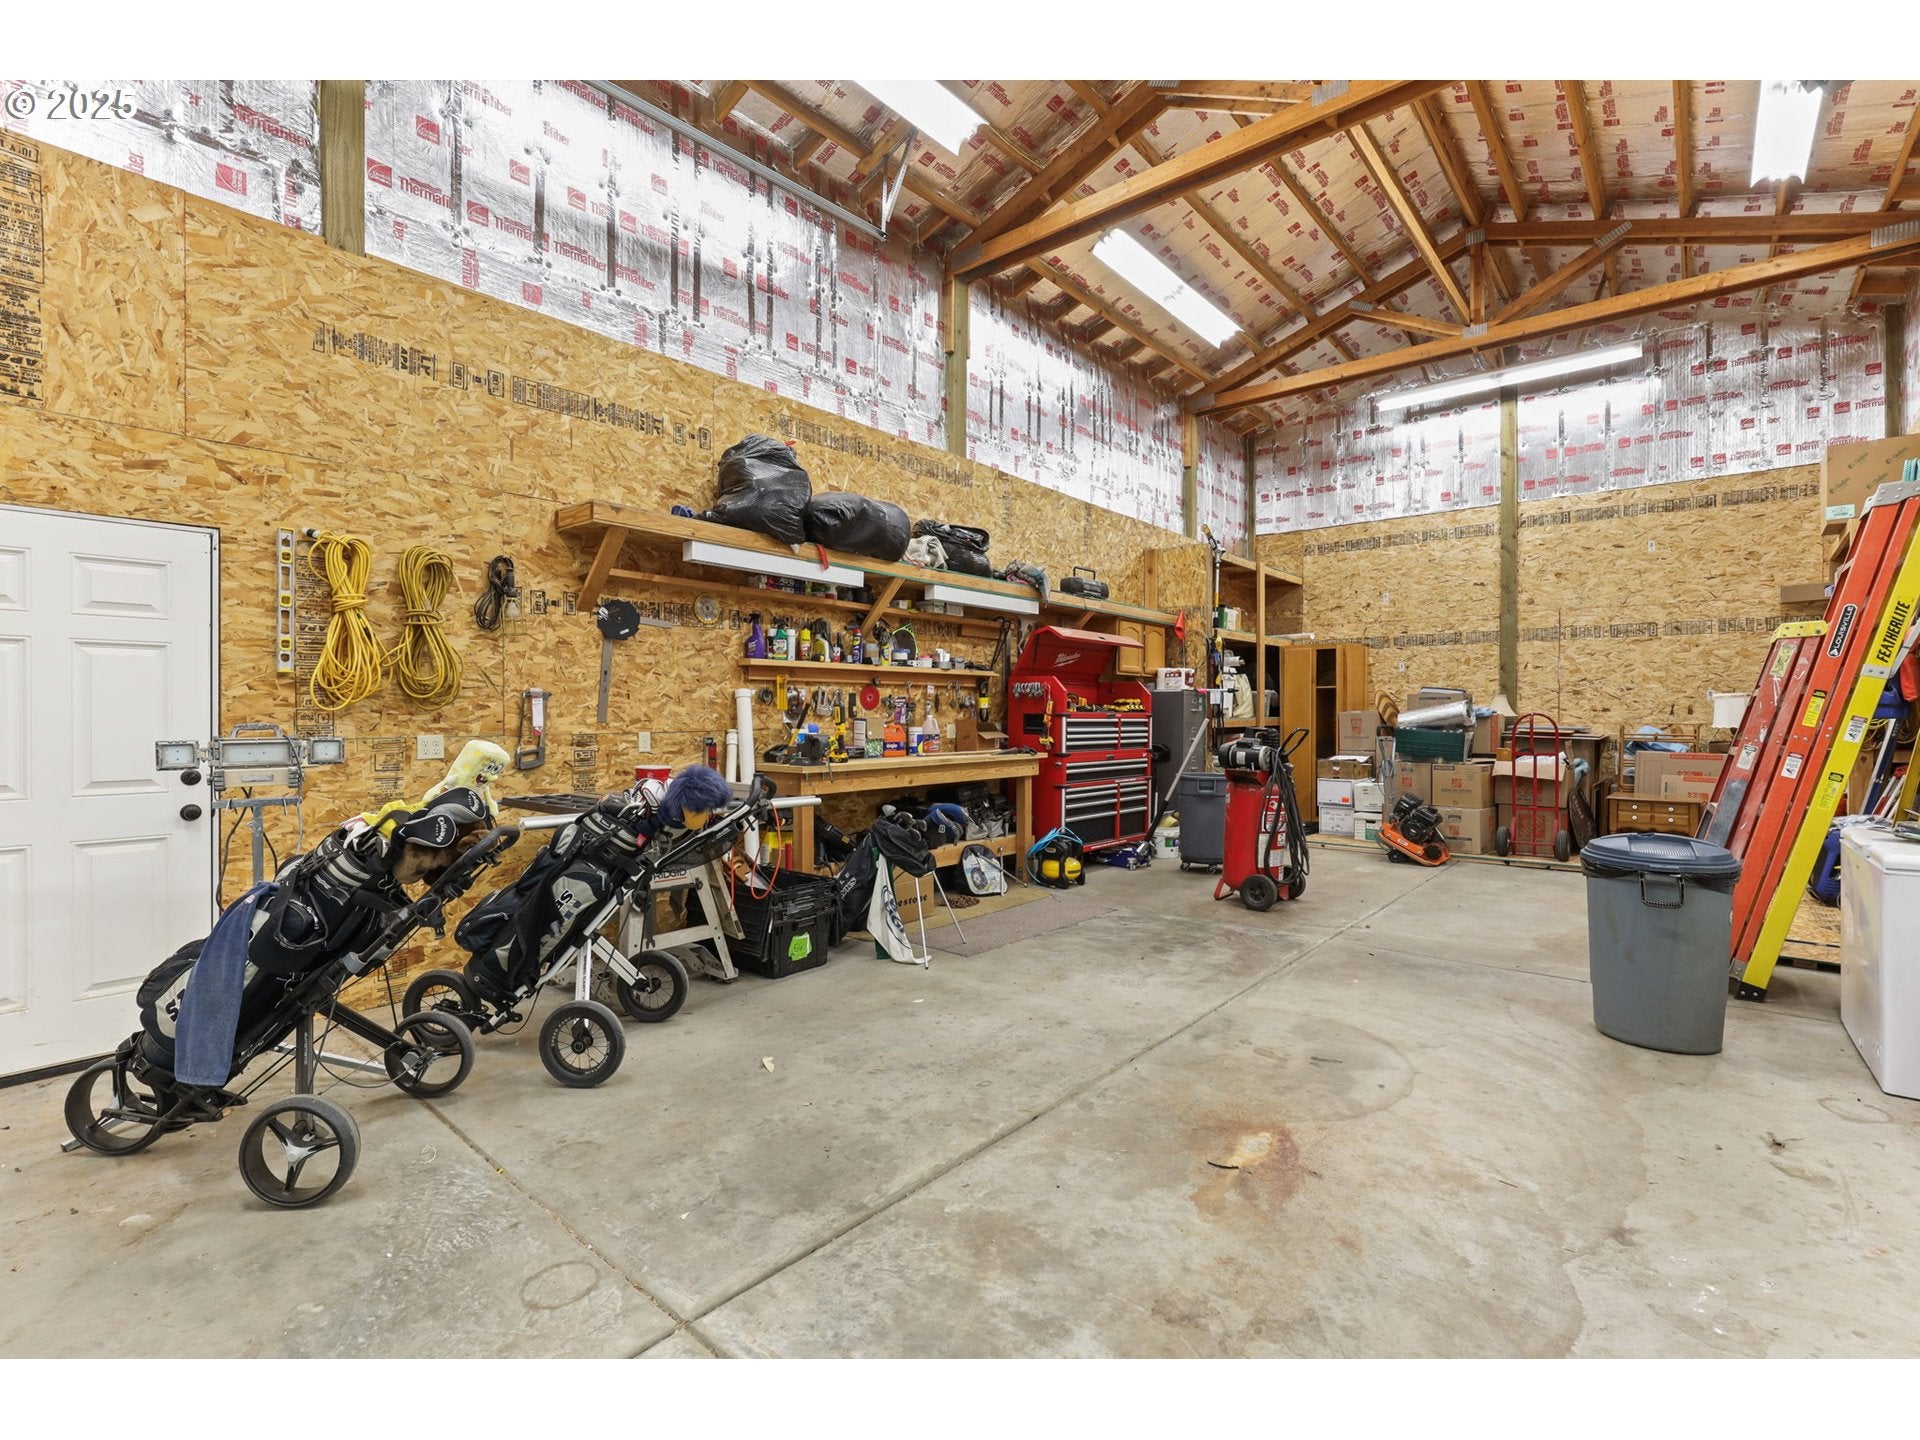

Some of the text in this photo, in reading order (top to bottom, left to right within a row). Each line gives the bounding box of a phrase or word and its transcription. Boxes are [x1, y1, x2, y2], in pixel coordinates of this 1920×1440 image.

[399, 176, 451, 209] Thermafi
[615, 268, 656, 291] ermafiber
[1833, 605, 1854, 649] LOUISVILLE
[1876, 601, 1910, 664] FEATHERLITE
[436, 817, 448, 843] Callaway
[898, 894, 929, 907] estone
